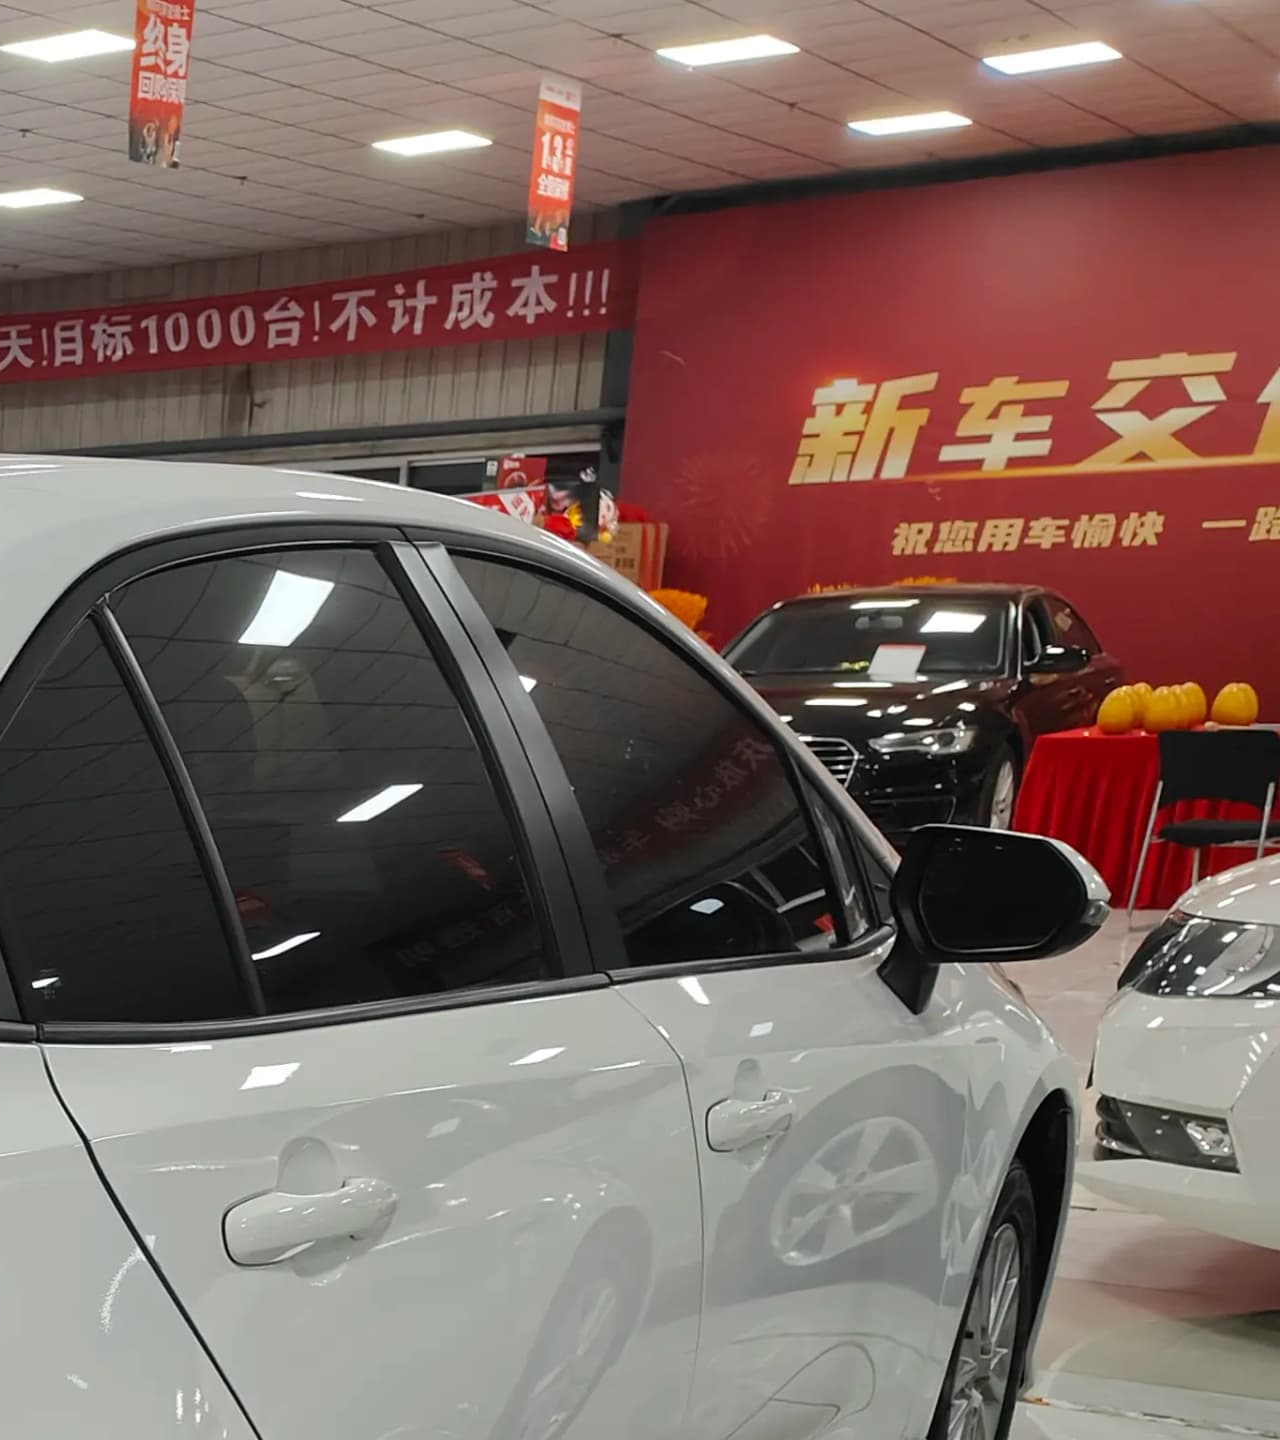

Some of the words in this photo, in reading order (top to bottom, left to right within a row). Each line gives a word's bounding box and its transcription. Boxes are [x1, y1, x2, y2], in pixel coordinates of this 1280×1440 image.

[140, 13, 190, 77] 终身
[891, 511, 1165, 556] 祝您用车愉快
